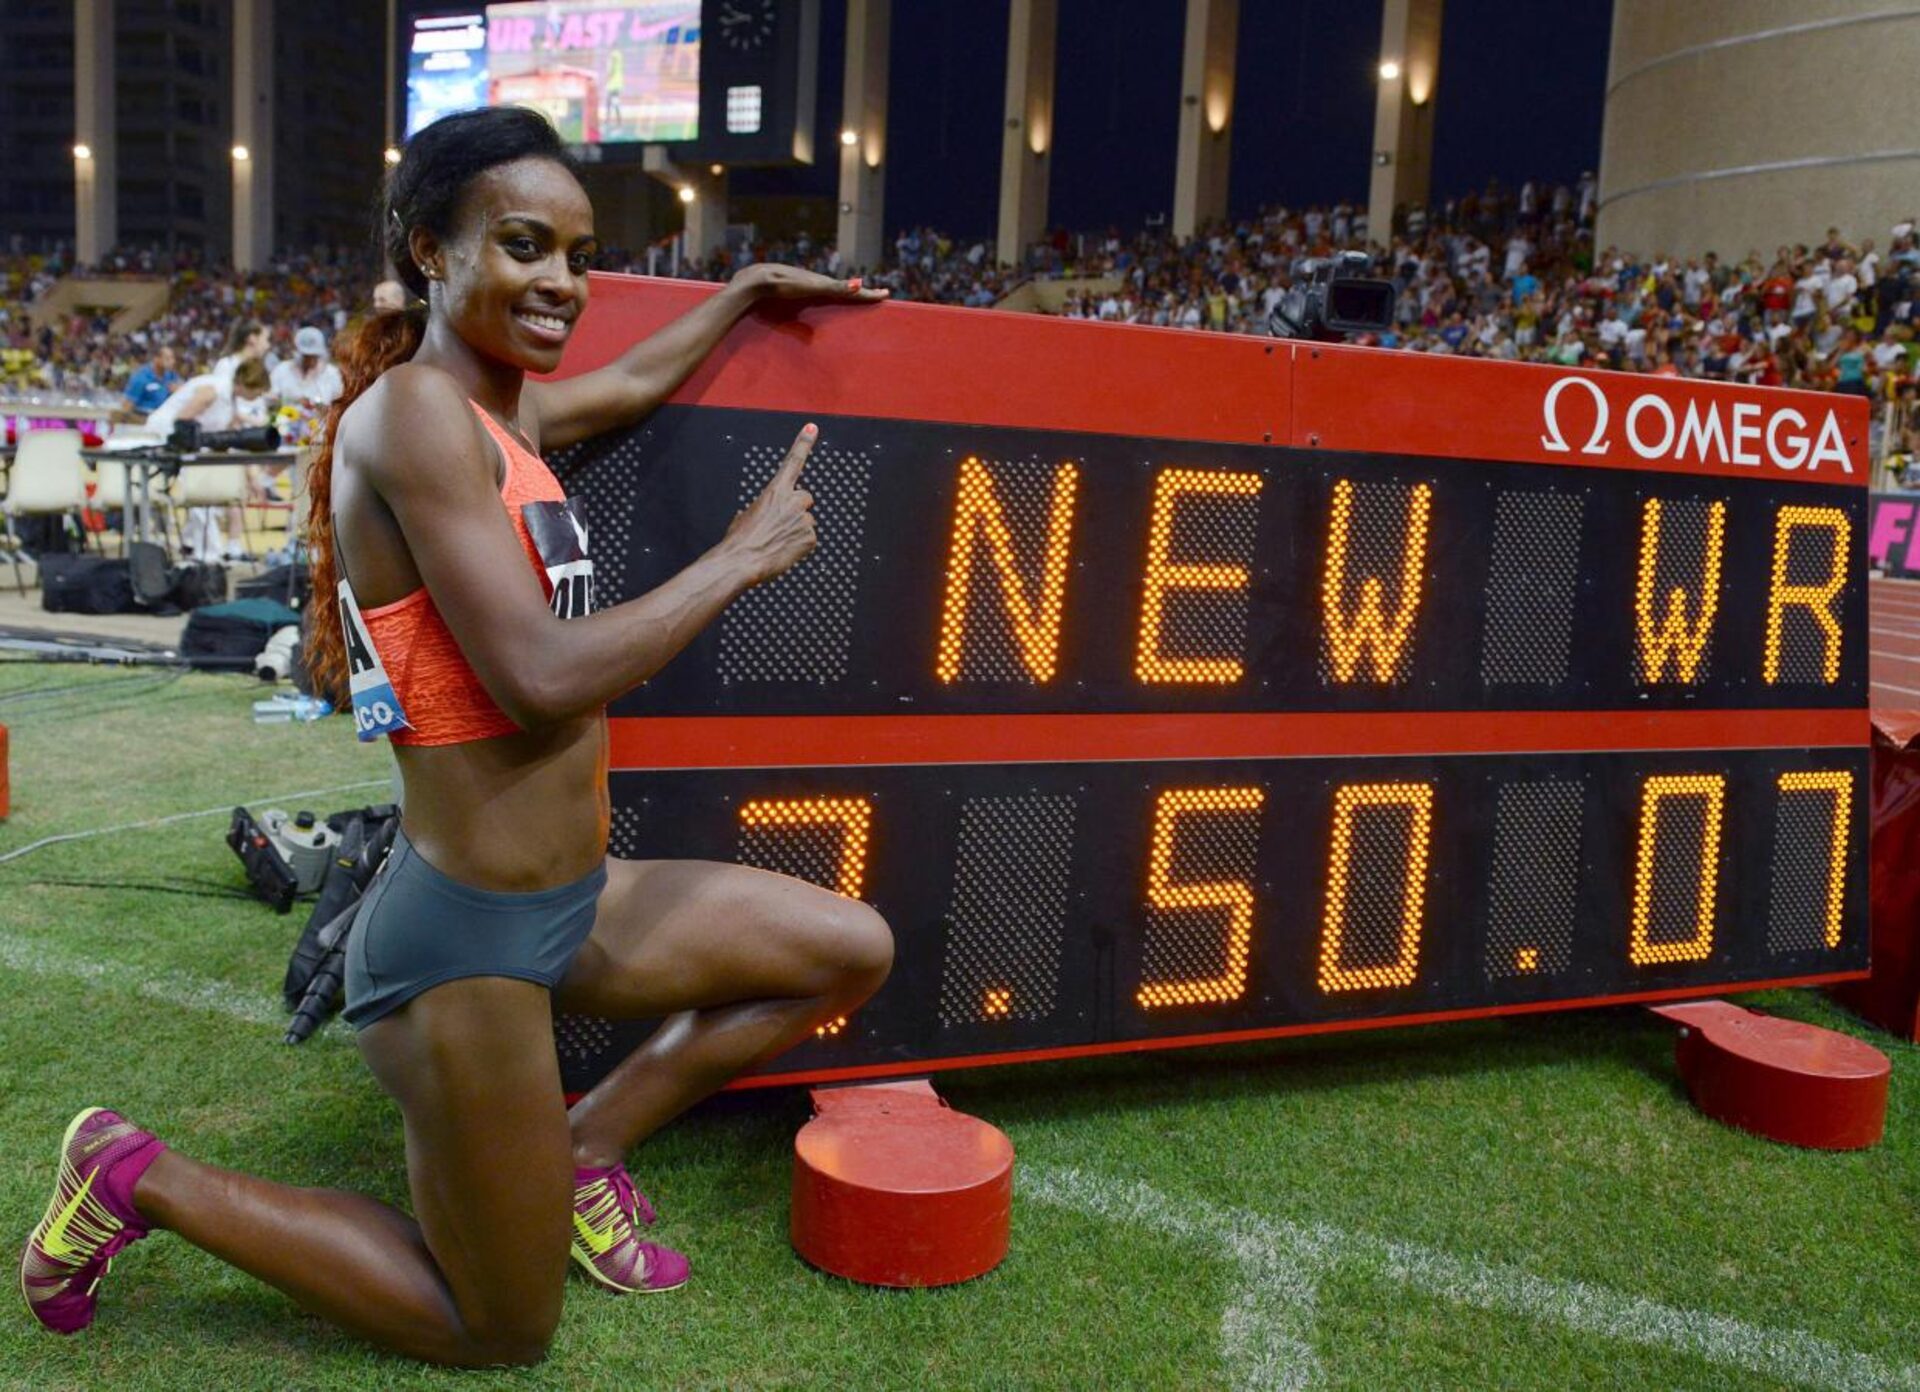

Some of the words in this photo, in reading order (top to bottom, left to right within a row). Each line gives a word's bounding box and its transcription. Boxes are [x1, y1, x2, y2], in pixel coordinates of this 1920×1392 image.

[544, 11, 624, 49] AST
[1626, 393, 1854, 474] OMEGA
[936, 456, 1433, 684] NEW
[1634, 497, 1852, 684] WR
